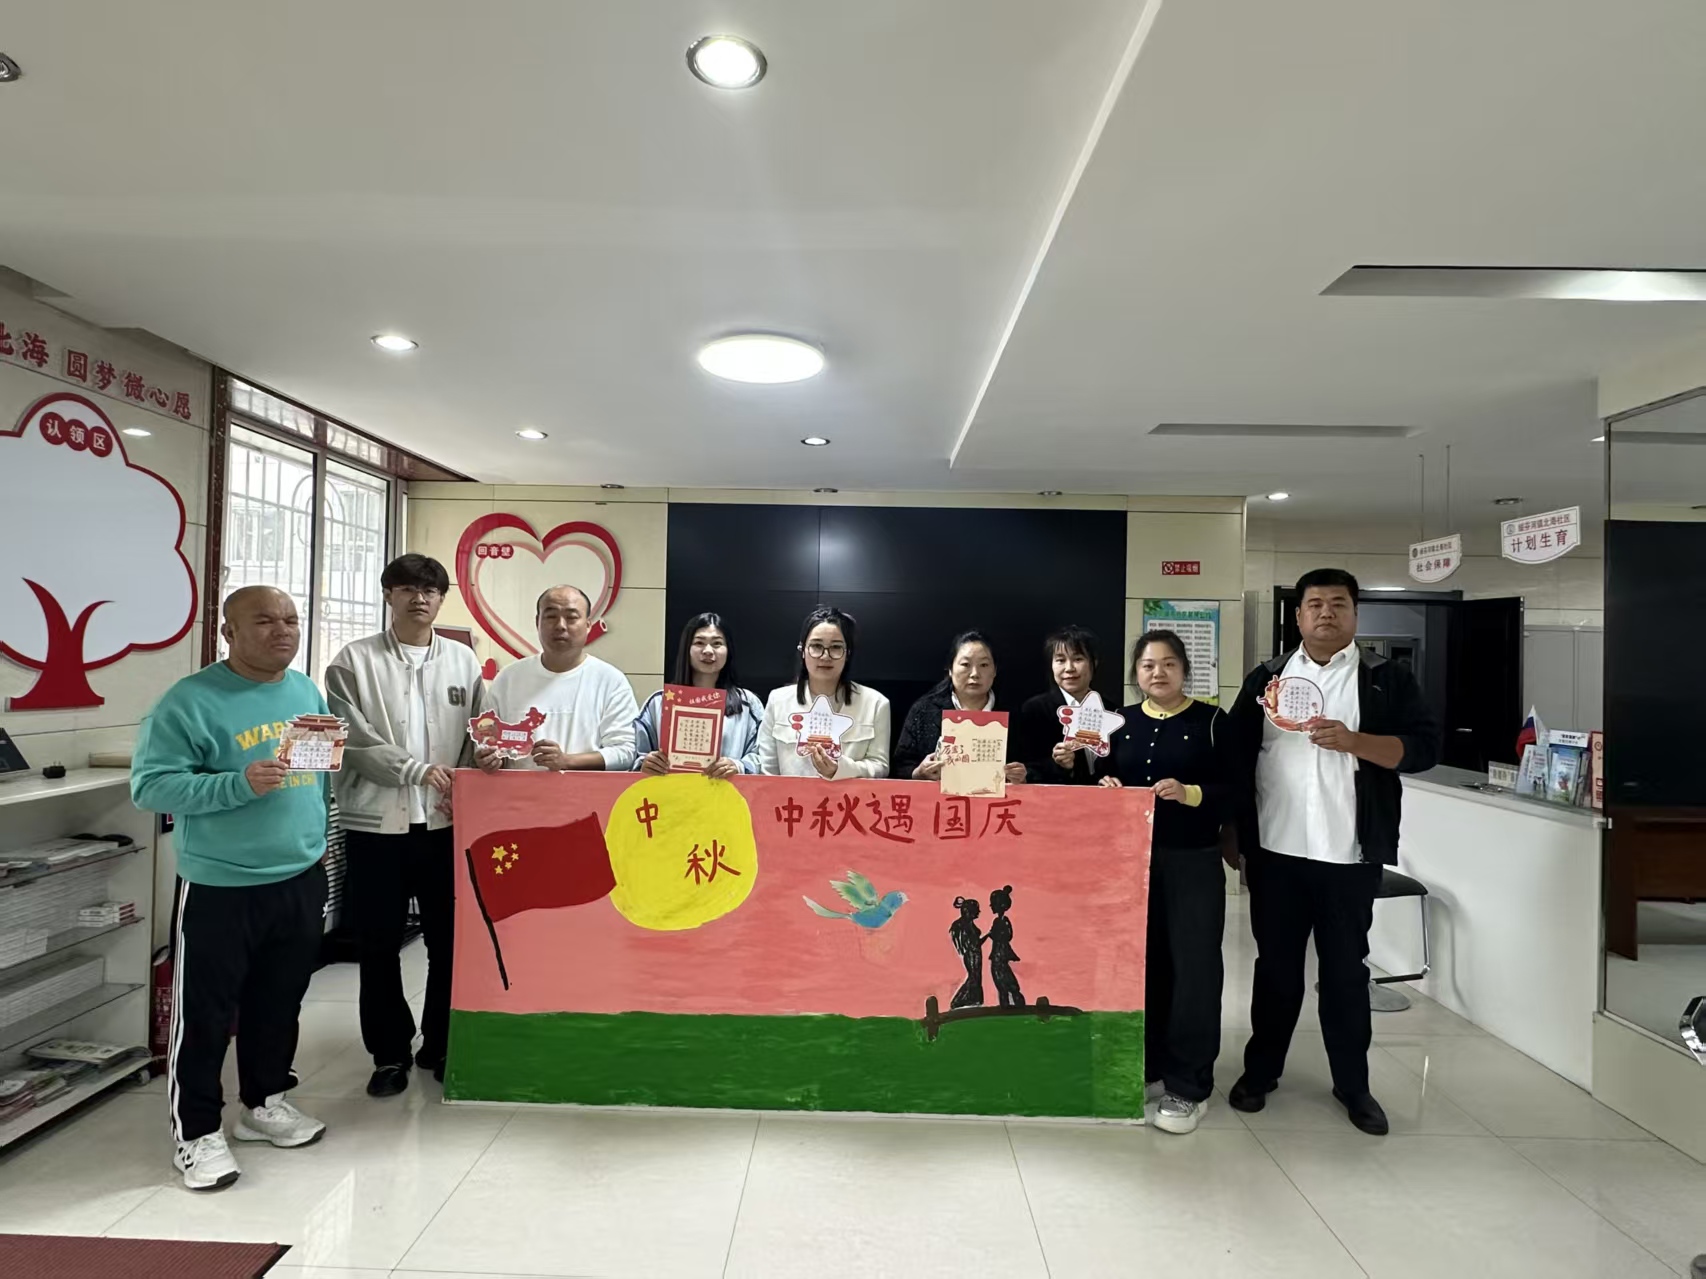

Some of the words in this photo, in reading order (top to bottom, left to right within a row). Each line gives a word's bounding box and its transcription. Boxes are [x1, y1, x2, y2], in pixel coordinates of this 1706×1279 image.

[66, 348, 192, 420] 圆梦微心愿
[46, 418, 107, 451] 认领区
[477, 545, 512, 558] 回音壁
[1511, 529, 1568, 553] 计划生育
[1416, 557, 1451, 573] 社会保障
[688, 691, 722, 705] 祖国我爱你
[775, 793, 1023, 844] 中秋遇国庆
